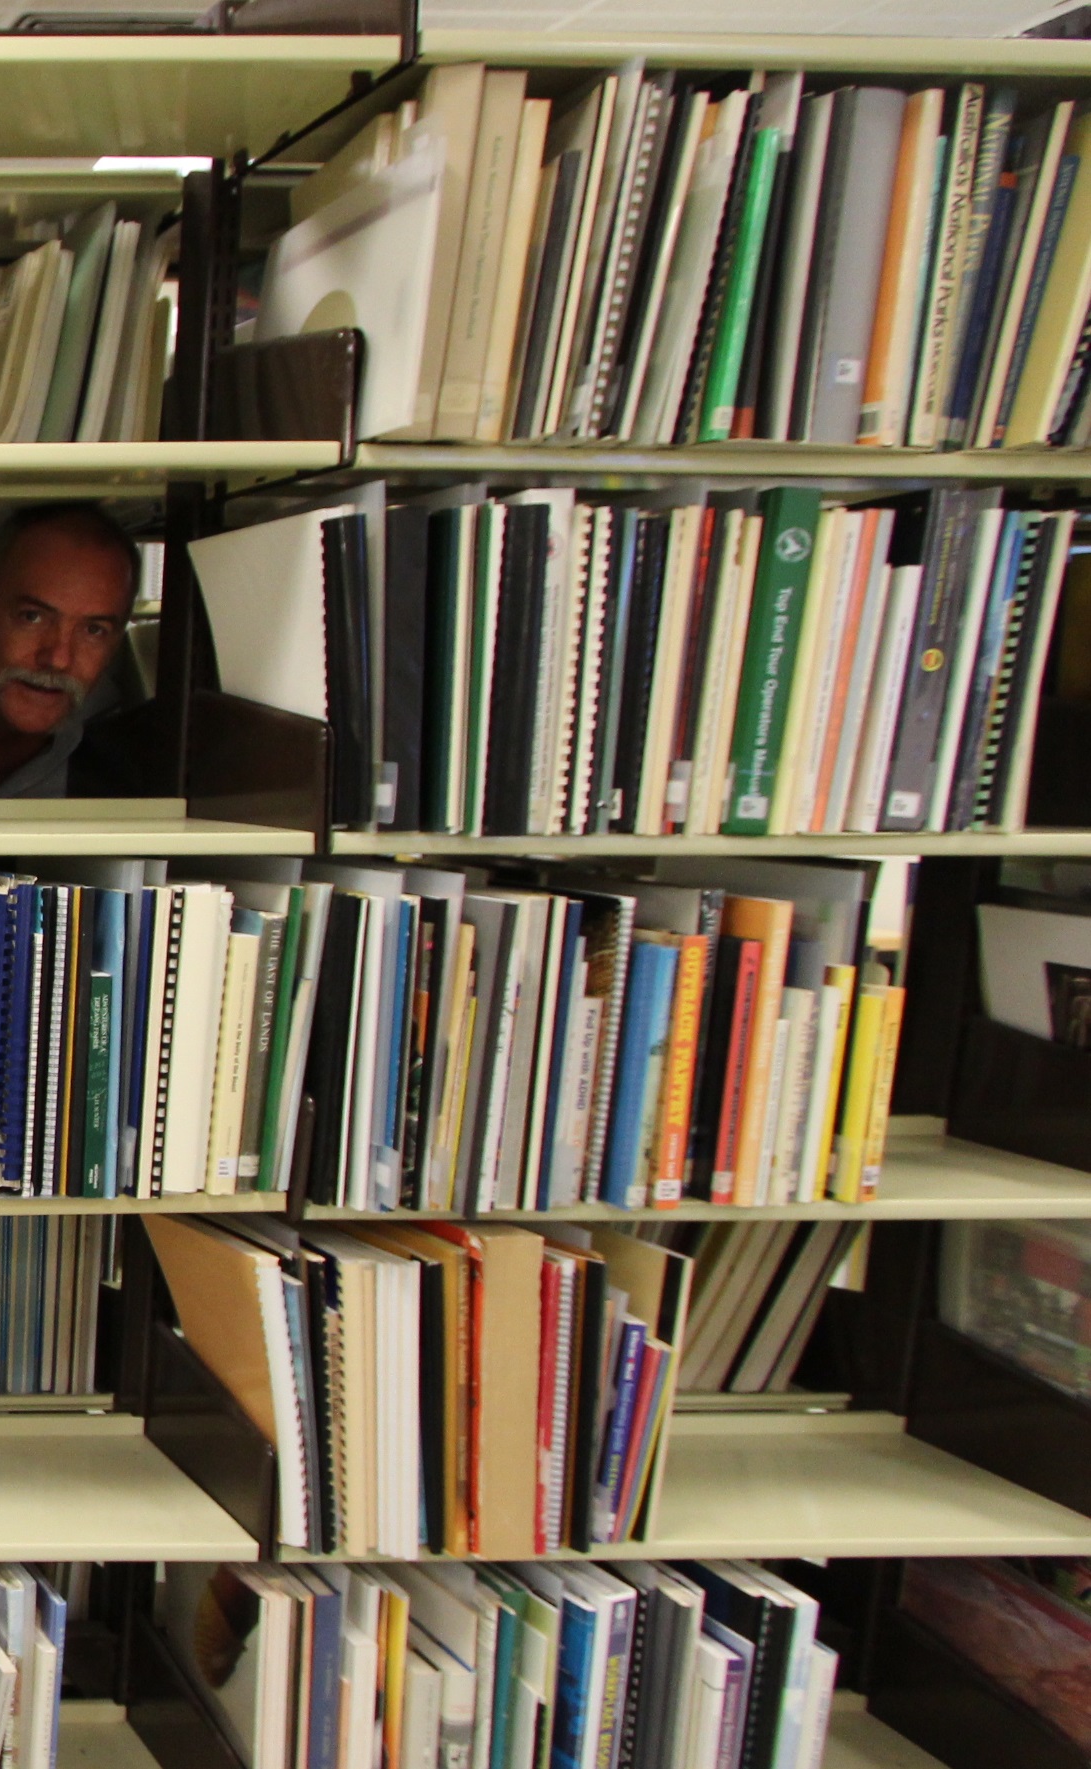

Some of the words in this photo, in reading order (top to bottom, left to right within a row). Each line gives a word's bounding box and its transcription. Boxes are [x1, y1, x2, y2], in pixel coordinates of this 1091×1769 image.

[940, 192, 968, 281] National
[932, 286, 953, 337] Parks
[776, 587, 794, 612] Top
[770, 615, 789, 643] End
[766, 647, 785, 676] Tour
[754, 679, 780, 747] Operators
[269, 928, 281, 950] THE
[264, 956, 278, 984] LAST
[264, 990, 275, 1006] OF
[677, 946, 701, 1044] OUTBACK
[259, 1012, 272, 1052] LANDS
[586, 1009, 596, 1029] Fed
[583, 1033, 595, 1049] Up
[581, 1052, 592, 1075] with
[577, 1078, 589, 1110] ADHD
[668, 1048, 692, 1127] PANTRY
